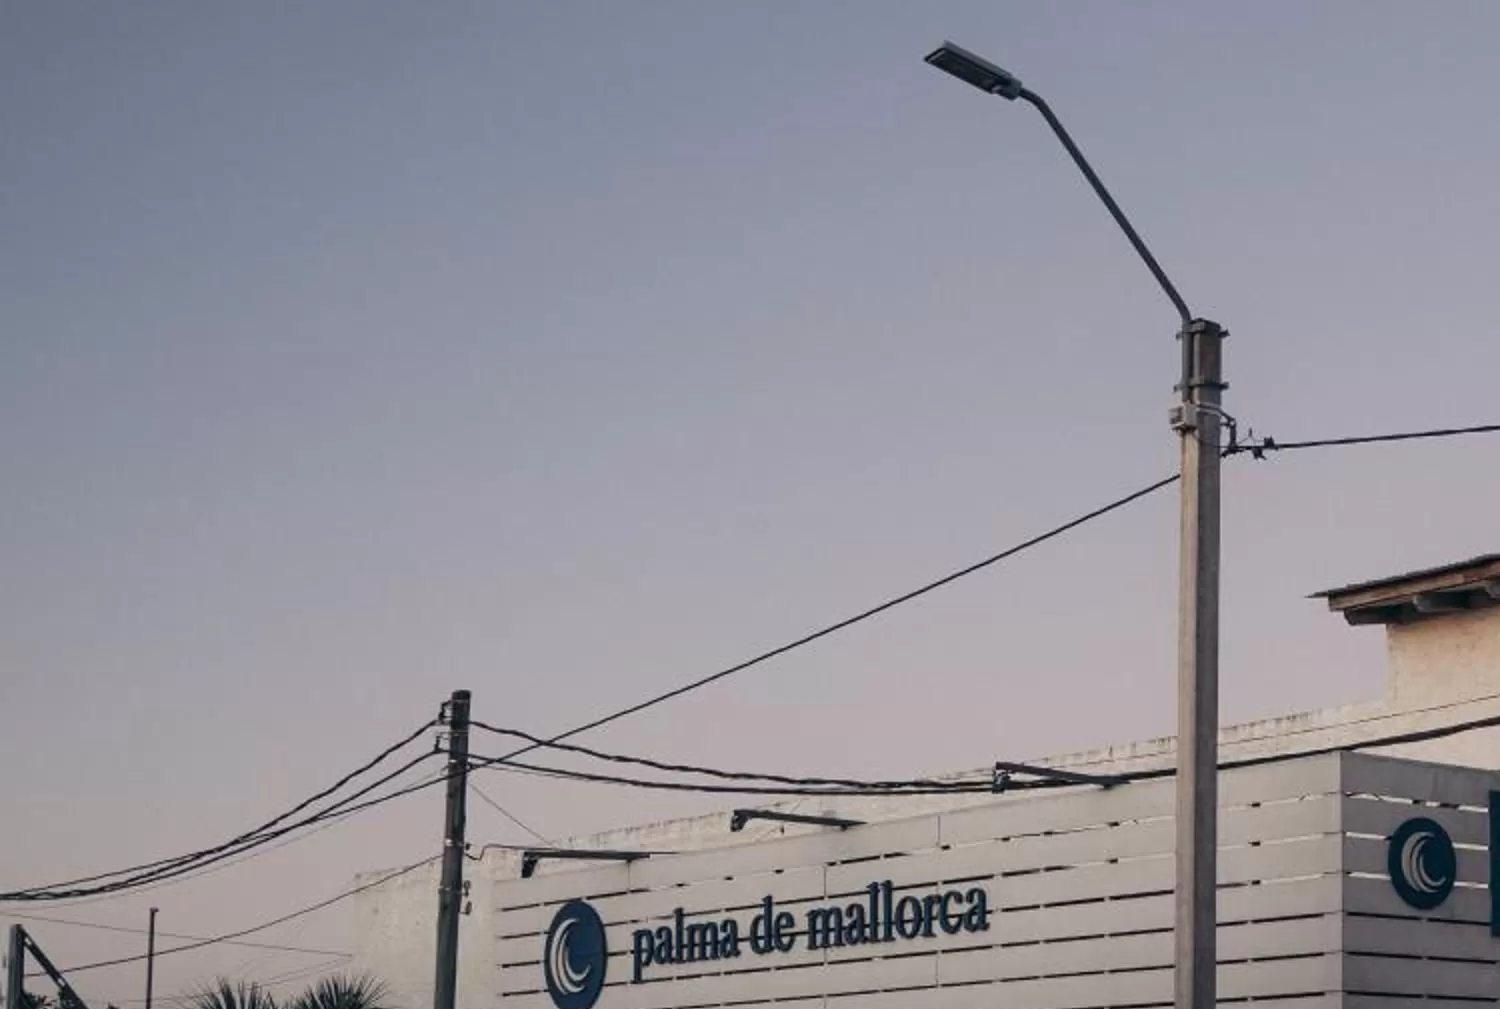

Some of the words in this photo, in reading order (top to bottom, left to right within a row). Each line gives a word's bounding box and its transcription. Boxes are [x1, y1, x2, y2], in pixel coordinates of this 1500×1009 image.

[633, 908, 740, 983] palma
[748, 896, 796, 955] de
[807, 880, 989, 949] mallorca
